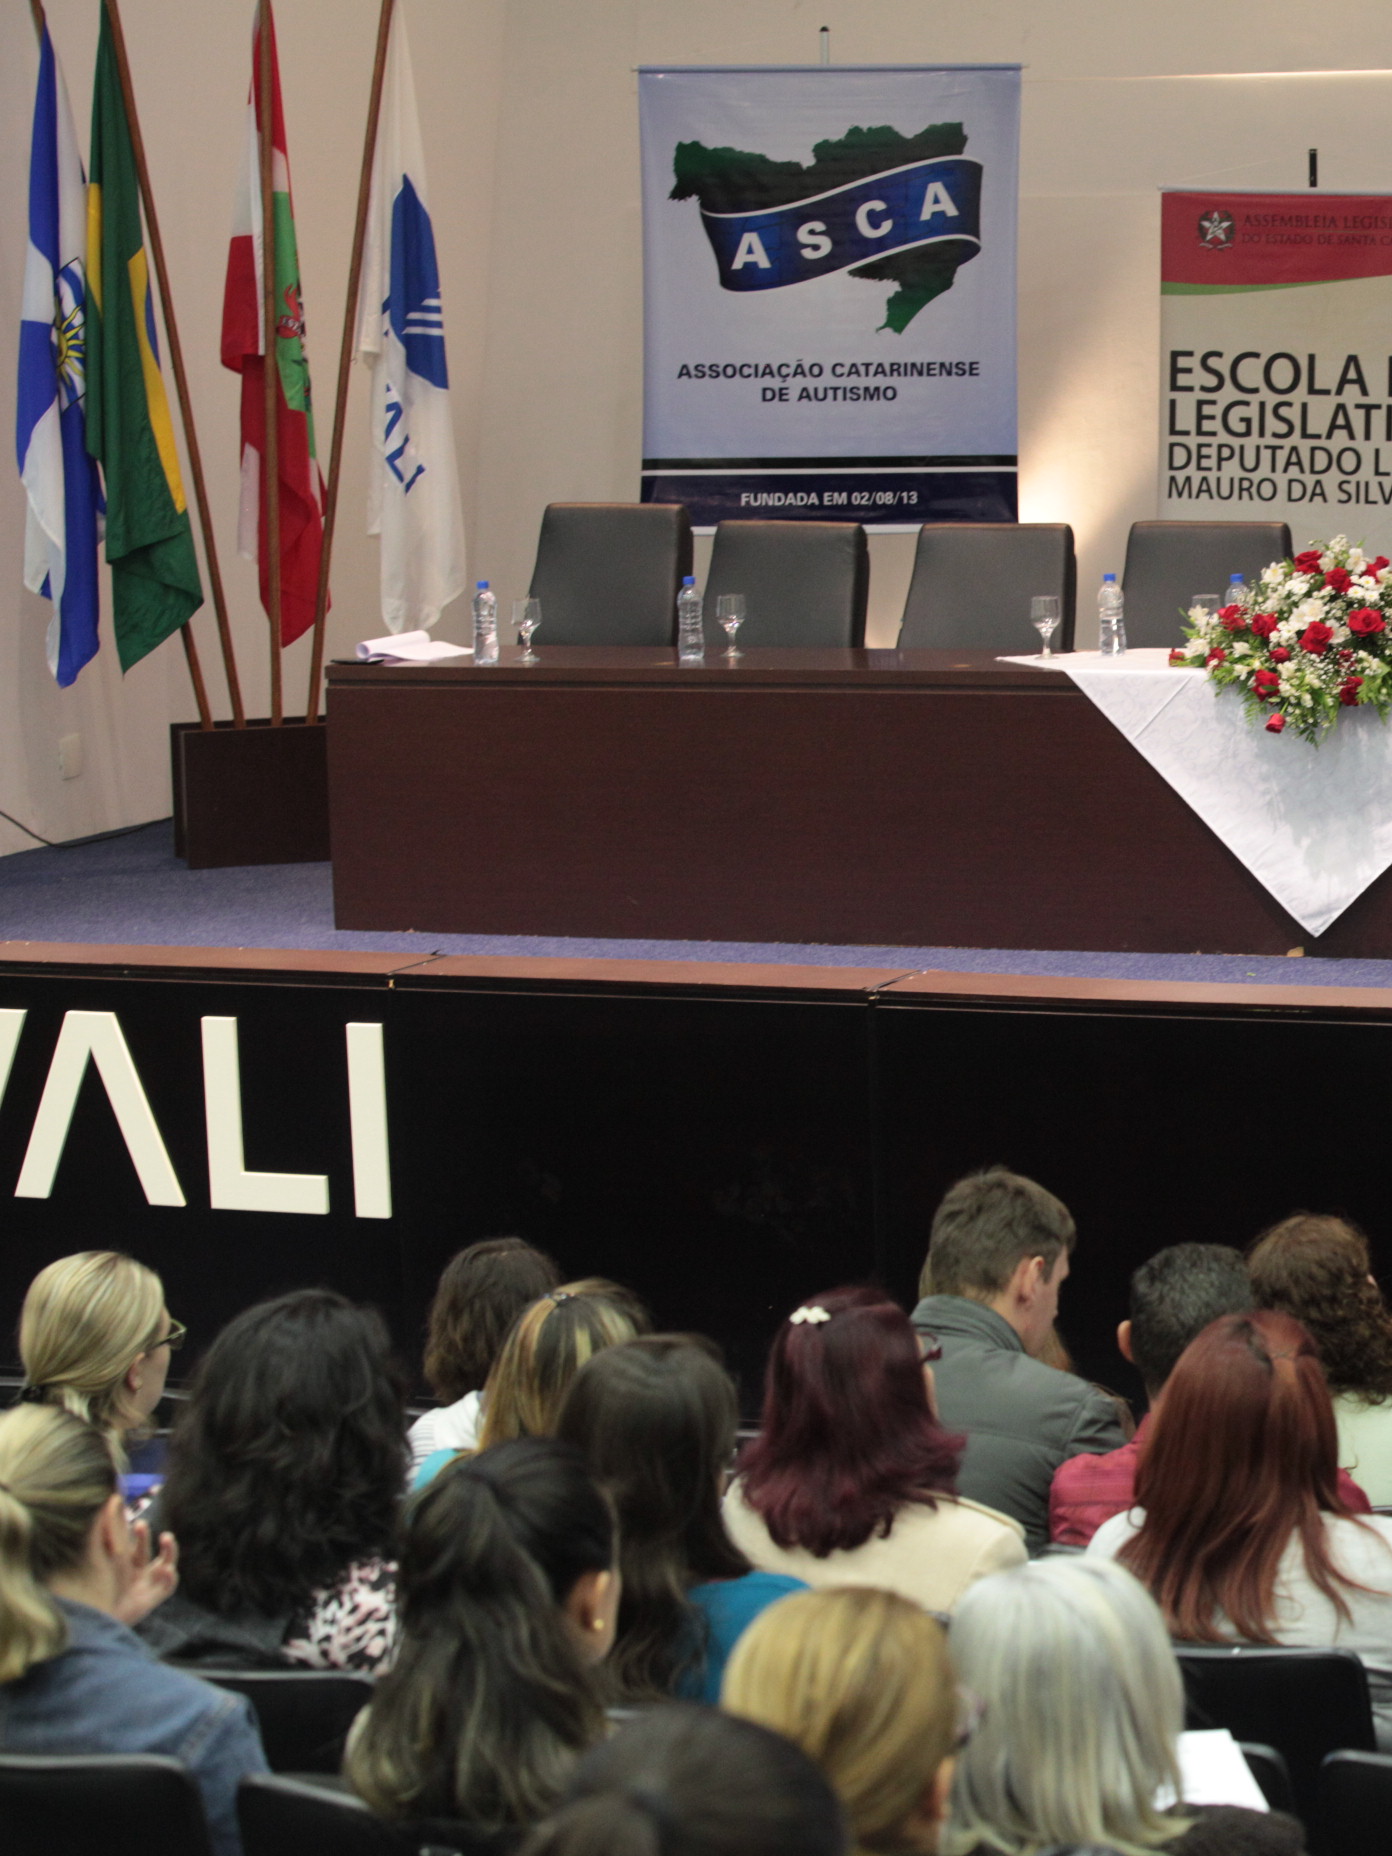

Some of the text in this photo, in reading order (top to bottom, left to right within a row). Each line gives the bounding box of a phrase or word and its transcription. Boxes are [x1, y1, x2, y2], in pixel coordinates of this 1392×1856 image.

[731, 181, 959, 270] ASCA
[1243, 214, 1338, 229] ASSEMBLEIA
[1242, 233, 1260, 243] DO
[1266, 233, 1313, 245] ESTADO
[1317, 234, 1333, 245] DE
[1334, 234, 1377, 246] SANTA
[677, 359, 980, 383] ASSOCIAÇÃO CATARINENSE
[1169, 350, 1369, 397] ESCOLA
[761, 385, 898, 402] DE AUTISMO
[1167, 442, 1363, 476] DEPUTADO
[740, 491, 918, 507] FUNDADA EM 02/08/13
[1167, 475, 1278, 501] MAURO
[1286, 479, 1328, 503] DA
[0, 1008, 392, 1219] ALI
